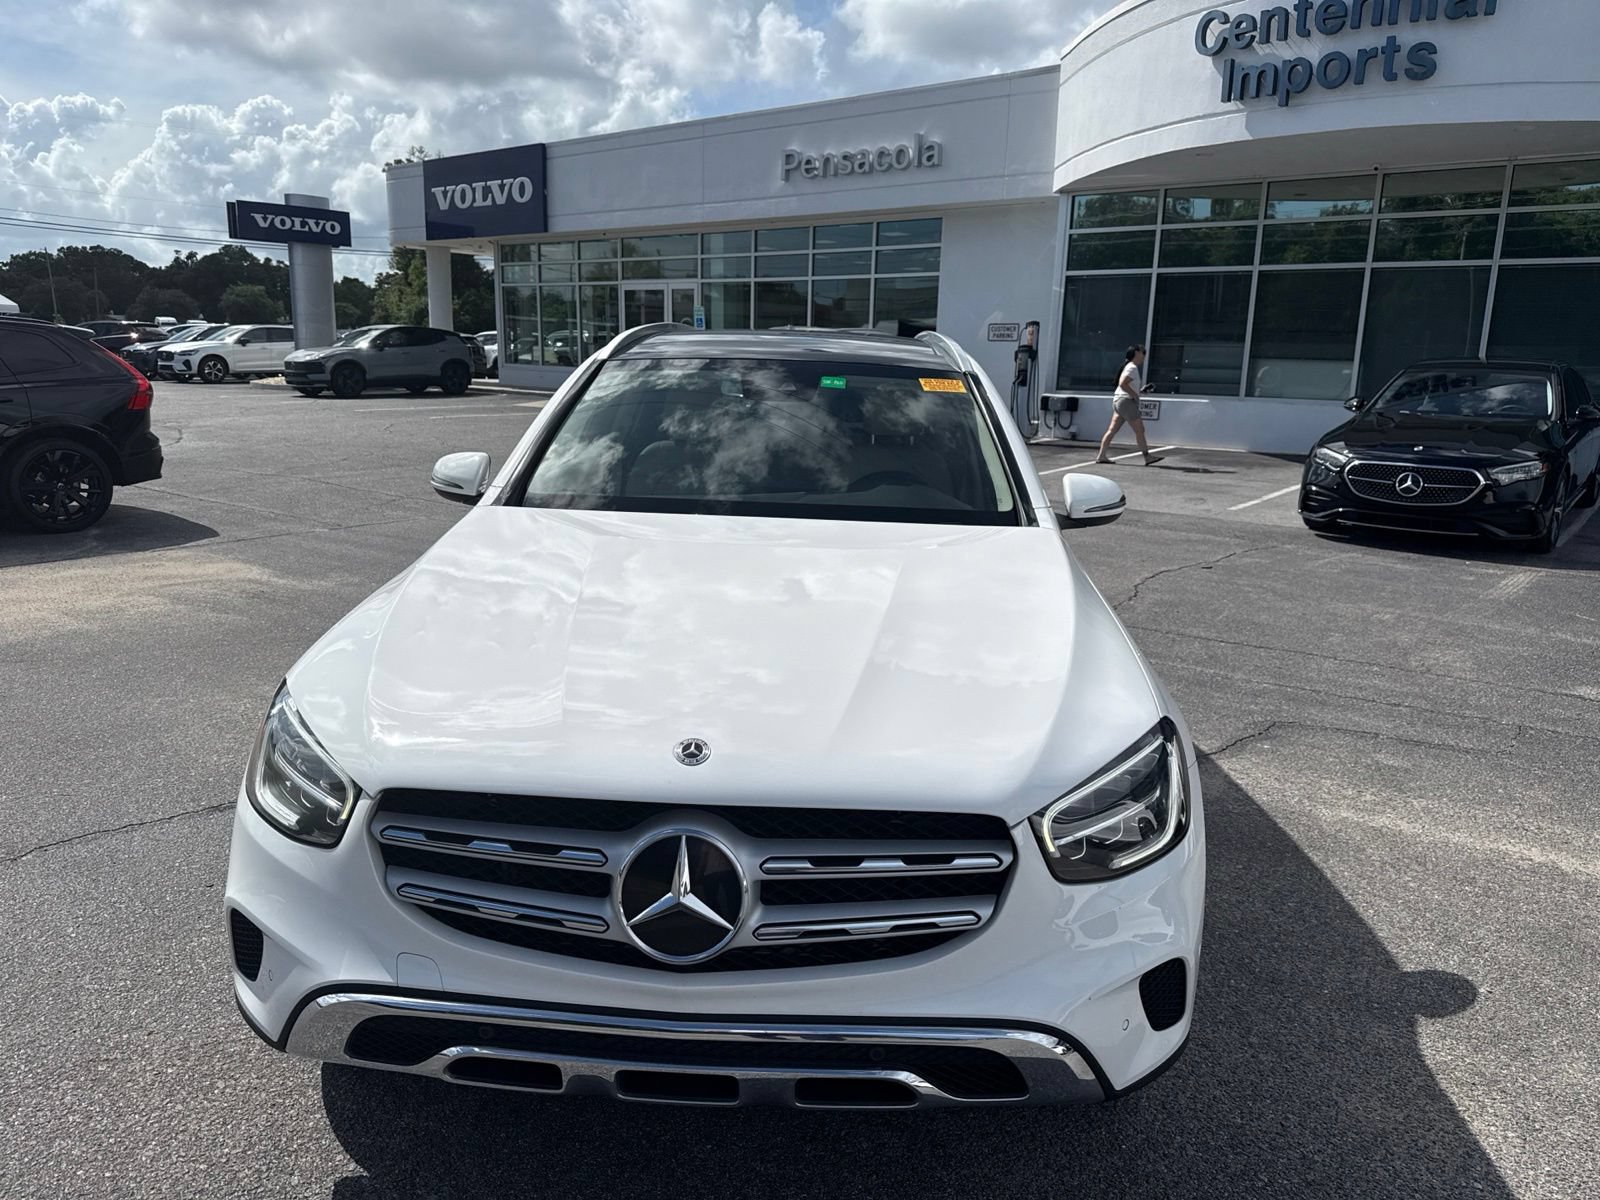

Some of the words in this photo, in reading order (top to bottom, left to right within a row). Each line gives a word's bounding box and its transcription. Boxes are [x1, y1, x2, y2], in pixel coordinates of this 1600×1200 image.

[1220, 35, 1438, 107] Imports
[781, 132, 943, 182] Pensacola
[431, 176, 533, 211] VOLVO
[251, 213, 341, 235] VOLVO
